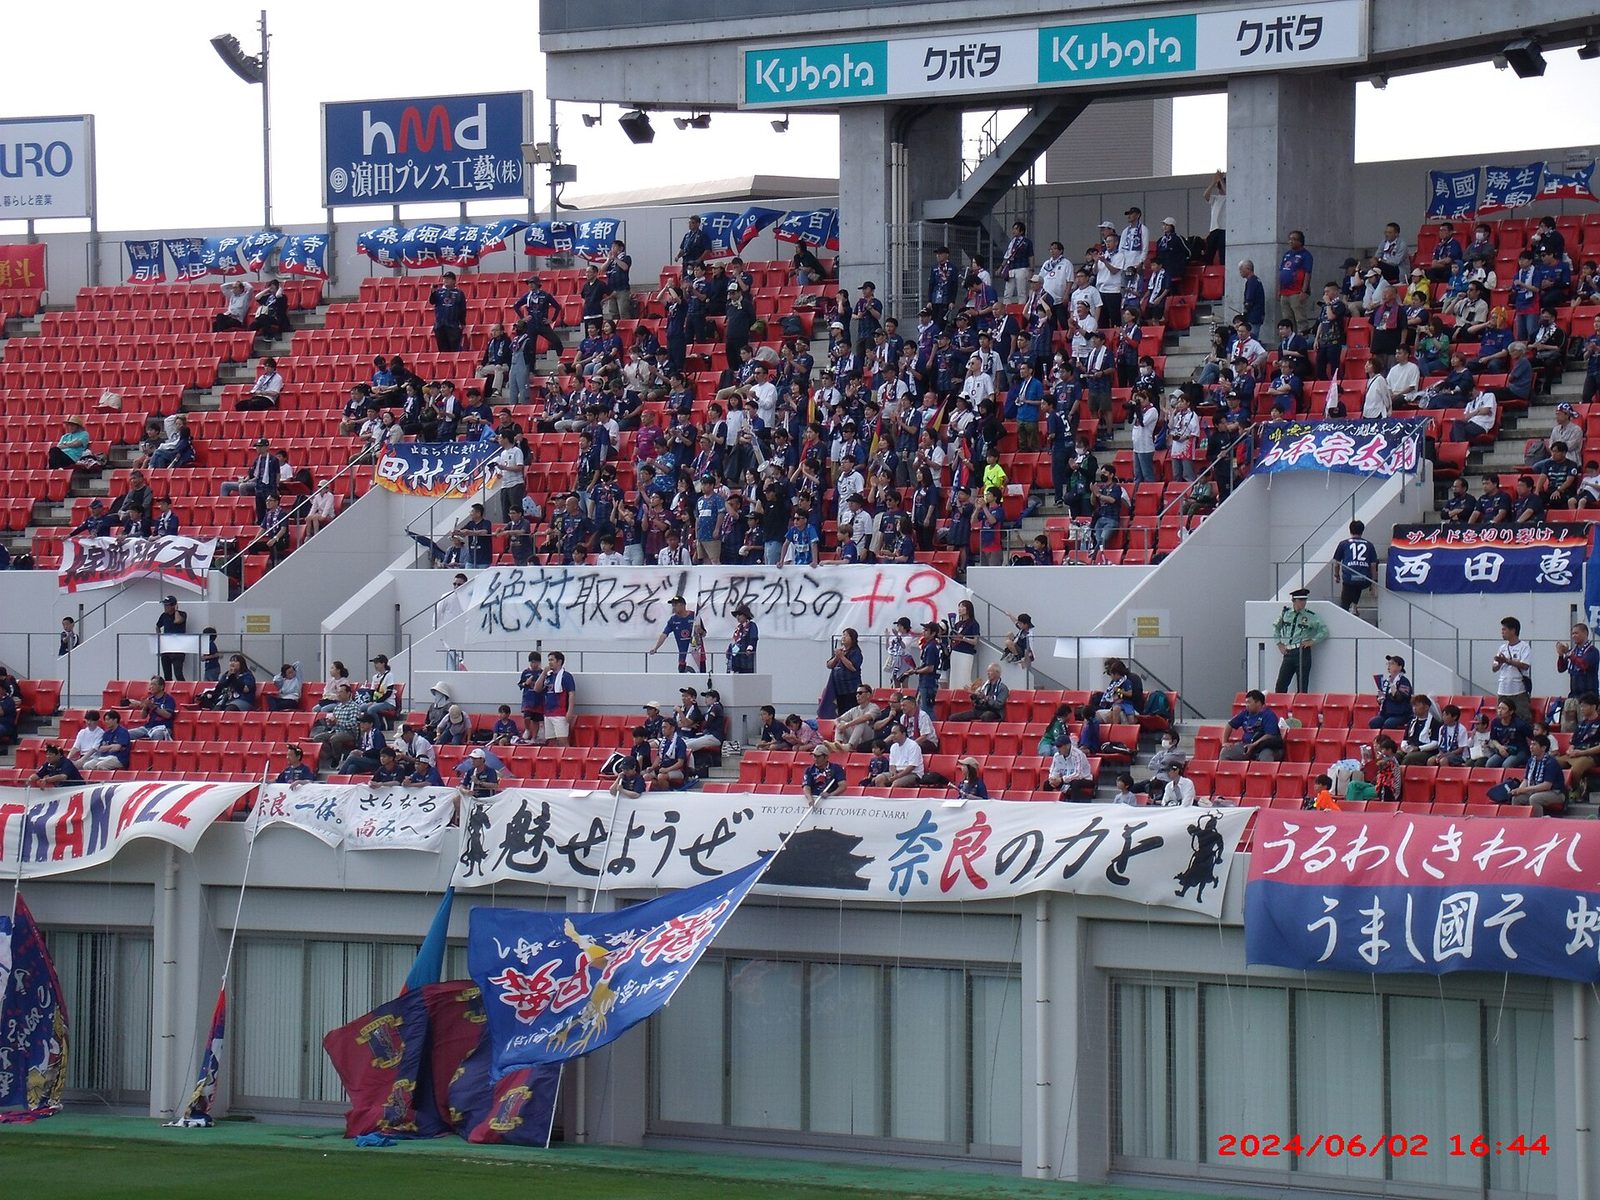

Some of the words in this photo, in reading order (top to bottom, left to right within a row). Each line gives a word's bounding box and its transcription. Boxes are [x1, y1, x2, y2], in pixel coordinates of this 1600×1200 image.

[1053, 35, 1182, 71] Kubota
[1236, 14, 1323, 56] クボタ
[755, 58, 874, 93] Kubota
[923, 43, 1001, 82] クボタ
[1350, 543, 1366, 561] 12
[1395, 548, 1573, 585] 西田恵
[795, 807, 834, 816] ATRACT
[491, 799, 755, 879] 魅せようぜ
